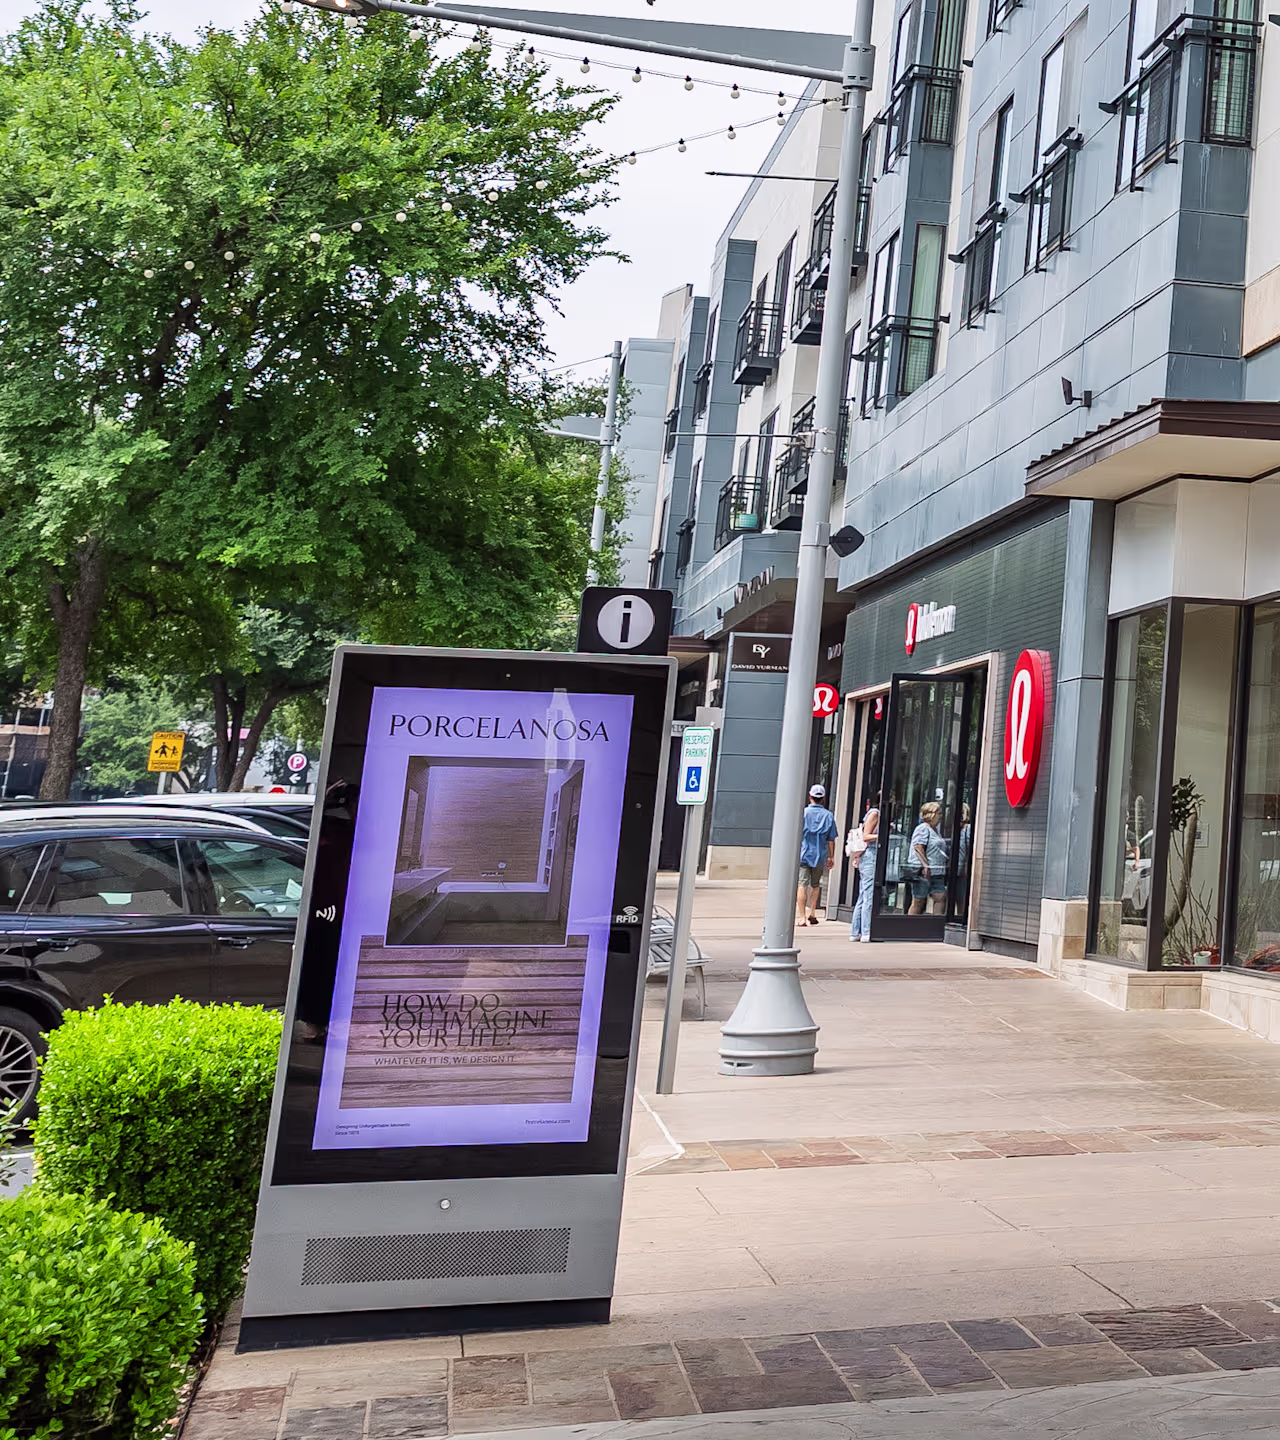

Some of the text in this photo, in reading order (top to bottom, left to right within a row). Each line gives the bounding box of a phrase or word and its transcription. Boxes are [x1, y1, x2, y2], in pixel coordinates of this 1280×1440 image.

[389, 714, 610, 742] PORCELANOSA
[685, 734, 710, 745] RESERVED
[685, 747, 708, 758] PARKING
[616, 915, 639, 924] RFID
[383, 993, 501, 1014] HOW DO
[381, 1010, 553, 1031] YOU IMAGINE
[379, 1027, 517, 1048] YOUR LIFE?
[374, 1056, 427, 1066] WHATEVER
[429, 1056, 439, 1065] IT
[453, 1055, 468, 1064] WE
[470, 1055, 505, 1064] DESIGN
